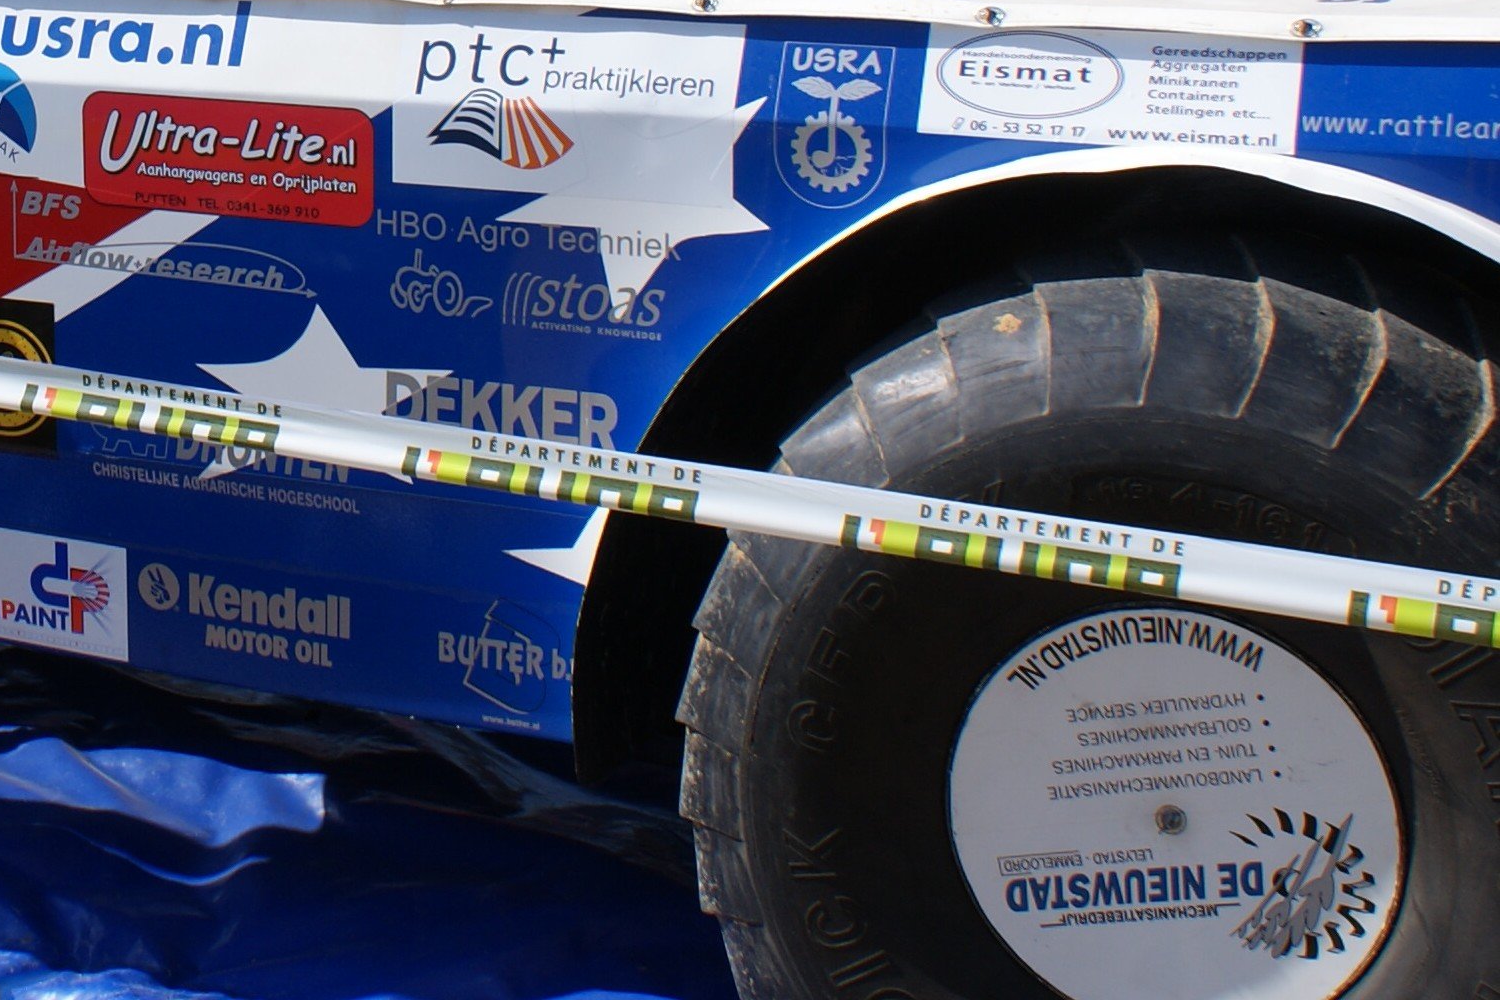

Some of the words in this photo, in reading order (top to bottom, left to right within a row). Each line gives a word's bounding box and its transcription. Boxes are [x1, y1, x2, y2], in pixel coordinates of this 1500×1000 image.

[792, 47, 882, 75] USRA
[1151, 60, 1247, 74] Aggregaten
[1152, 45, 1287, 62] Gereedschappen
[543, 66, 715, 97] praktijkleren
[959, 60, 1092, 83] Eismat
[1148, 75, 1238, 89] Minikranen
[1147, 89, 1235, 103] Containers
[1146, 103, 1225, 119] Stellingen
[970, 120, 987, 131] 06
[1003, 122, 1020, 133] 53
[1025, 123, 1043, 135] 52
[1050, 125, 1063, 136] 17
[1072, 126, 1085, 137] 17
[1108, 127, 1277, 147] www.eismat.nl
[137, 161, 244, 186] Aanhangwagens
[250, 172, 267, 186] en
[273, 172, 357, 195] Oprijplaten
[20, 190, 82, 220] BFS
[135, 192, 186, 208] PUTTEN
[294, 204, 320, 219] 910
[376, 209, 446, 240] HBO
[457, 216, 529, 251] Agro
[547, 224, 681, 261] Techniek
[531, 274, 666, 327] stoas
[531, 321, 591, 334] ACTIVATING
[597, 327, 662, 341] KNOWLEDGE
[82, 373, 243, 412] DÉPARTEMENT
[257, 400, 283, 418] DE
[386, 370, 618, 451] DEKKER
[471, 436, 656, 477] DÉPARTEMENT
[673, 466, 702, 484] DE
[93, 462, 179, 486] CHRISTELIJKE
[183, 477, 264, 500] AGRARISCHE
[268, 489, 360, 514] HOGESCHOOL
[919, 502, 1133, 549] DÉPARTEMENT
[1151, 536, 1186, 557] DE
[188, 572, 351, 640] Kendall
[205, 624, 288, 660] MOTOR
[295, 638, 332, 668] OIL
[438, 631, 544, 682] BUTTER
[1007, 616, 1264, 690] WWW.NIEUWSTAD.NL
[1066, 702, 1137, 722] SERVICE
[1142, 693, 1246, 714] HYDRAULIEK
[1077, 717, 1252, 747] GOLFBAANMACHINES
[1052, 749, 1183, 774] PARKMACHINES
[1189, 746, 1211, 760] EN
[1047, 768, 1263, 800] LANDBOUWMECHANISATIE
[1004, 855, 1082, 871] EMMELOORD
[1093, 849, 1153, 864] LELYSTAD
[1006, 865, 1207, 912] NIEUWSTAD
[1219, 861, 1264, 897] DE
[1059, 903, 1219, 926] MECHANISATIEBEDRIJF
